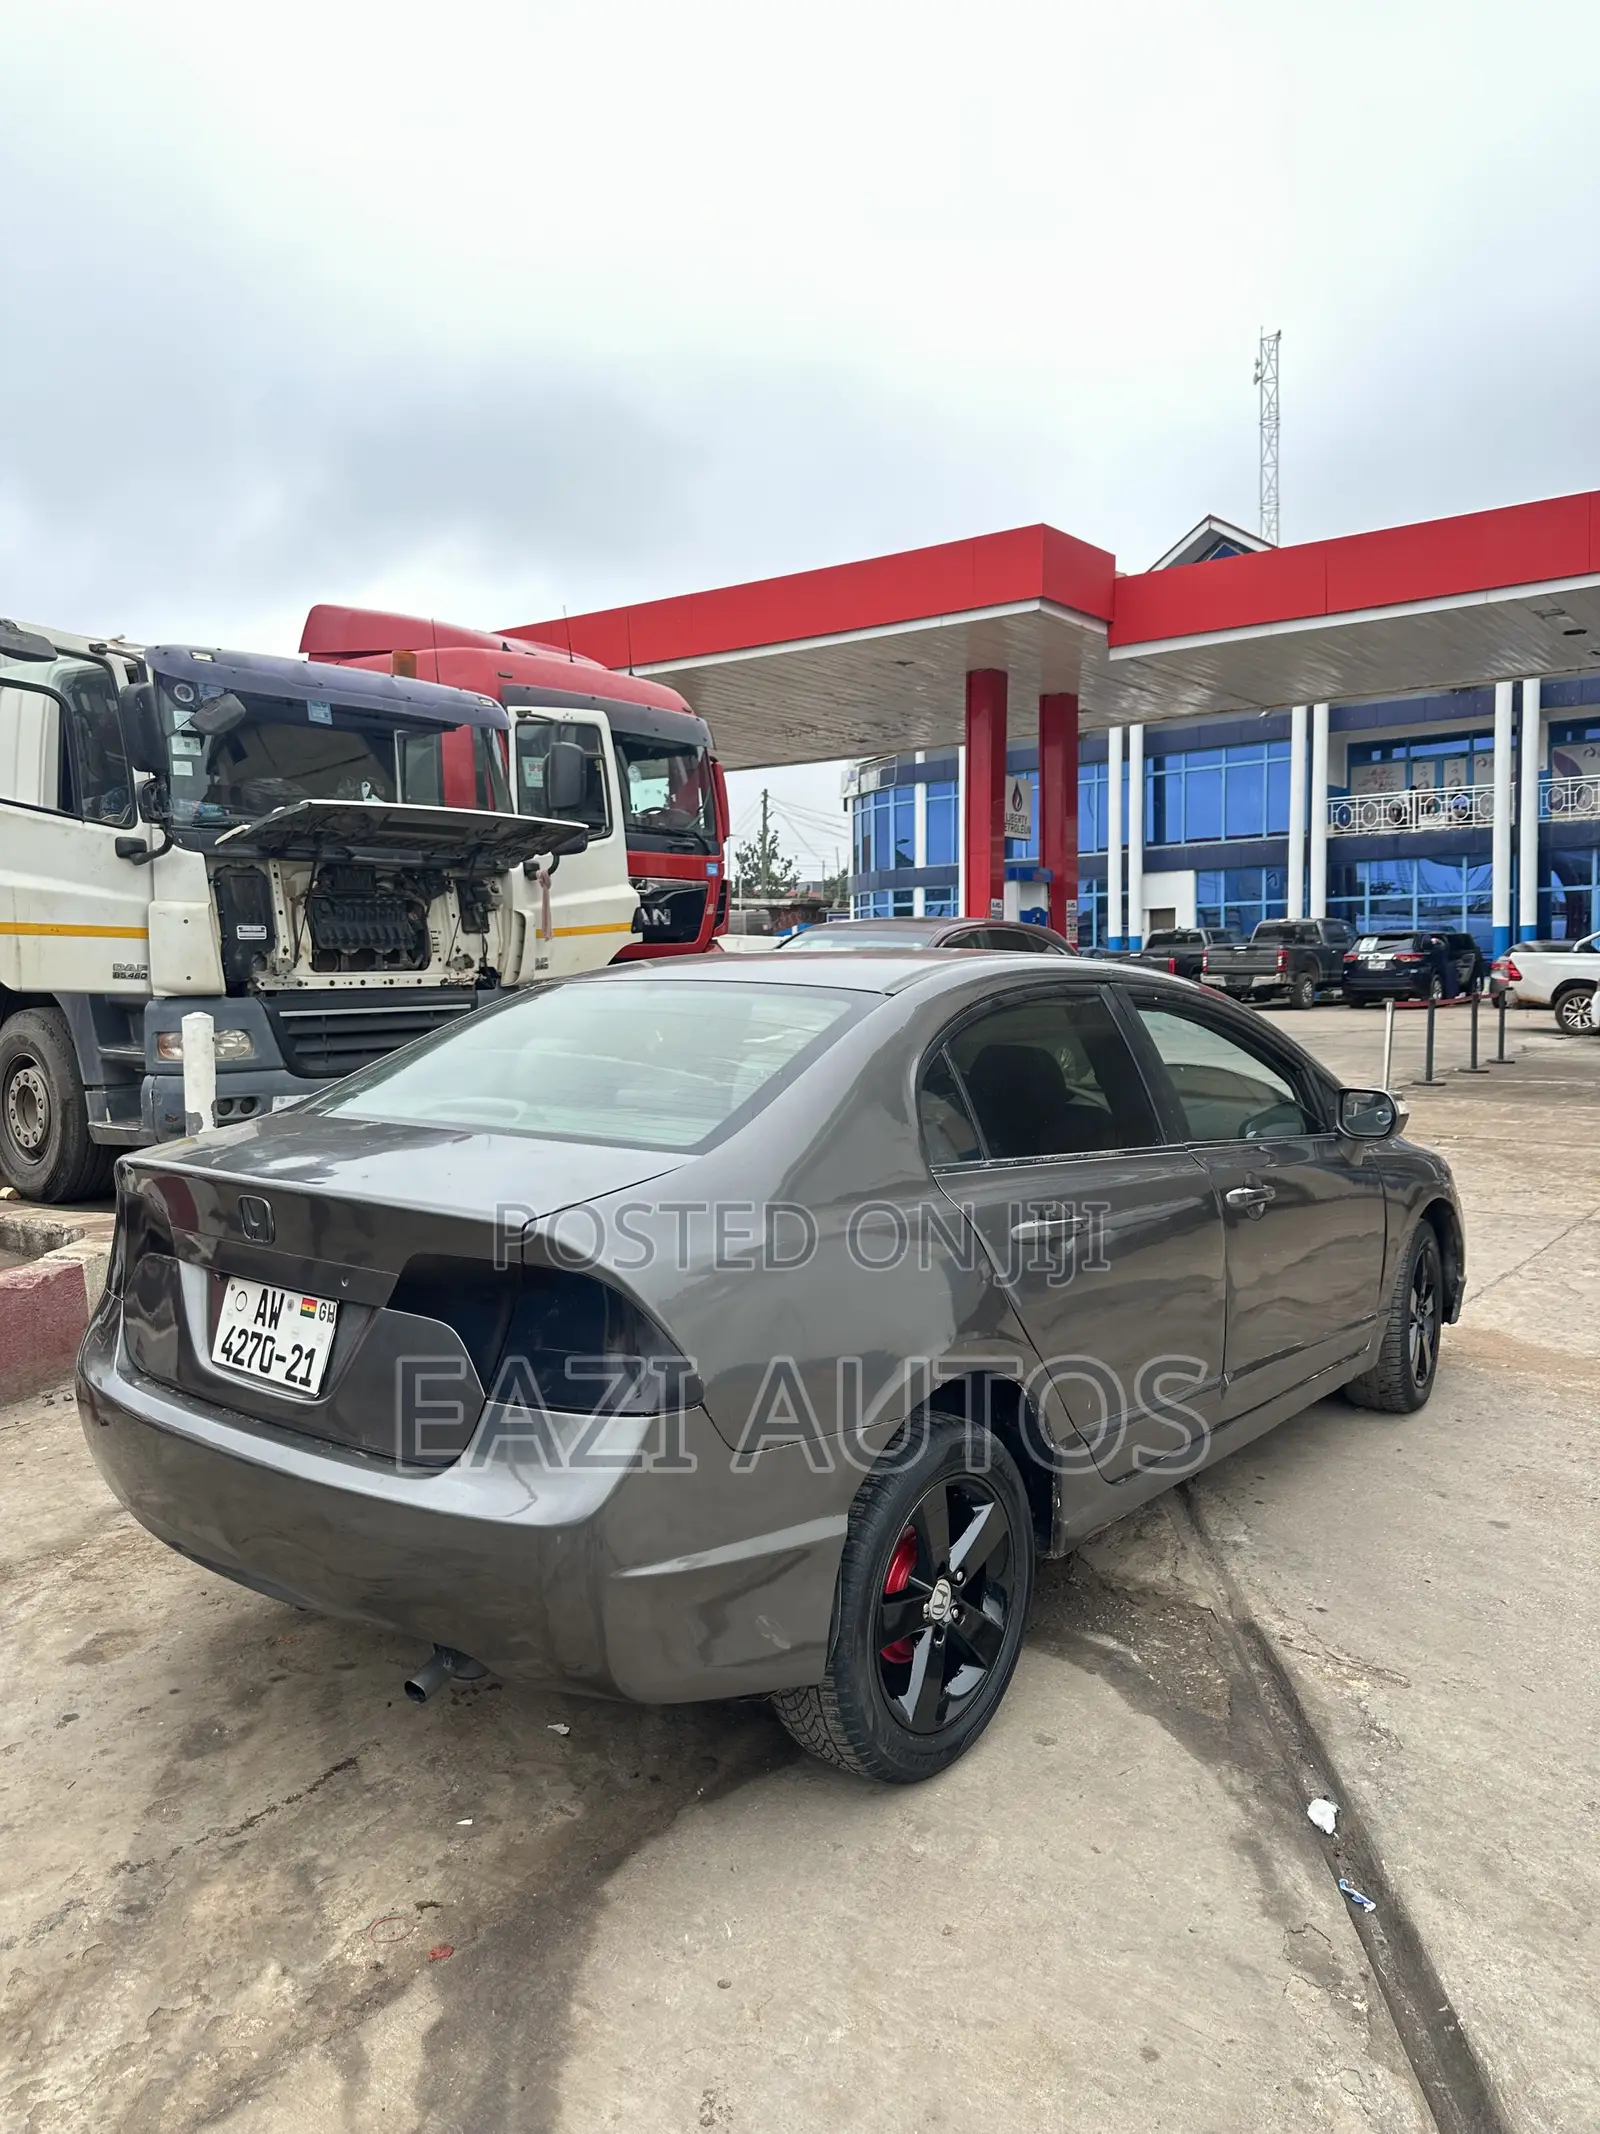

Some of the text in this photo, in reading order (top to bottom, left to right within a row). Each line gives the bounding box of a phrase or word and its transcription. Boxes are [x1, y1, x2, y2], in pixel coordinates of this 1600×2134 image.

[1004, 822, 1032, 835] ETROLEUM
[641, 907, 672, 927] AN
[253, 1288, 286, 1331] AW
[318, 1302, 336, 1324] GH
[220, 1325, 317, 1388] 4270-21
